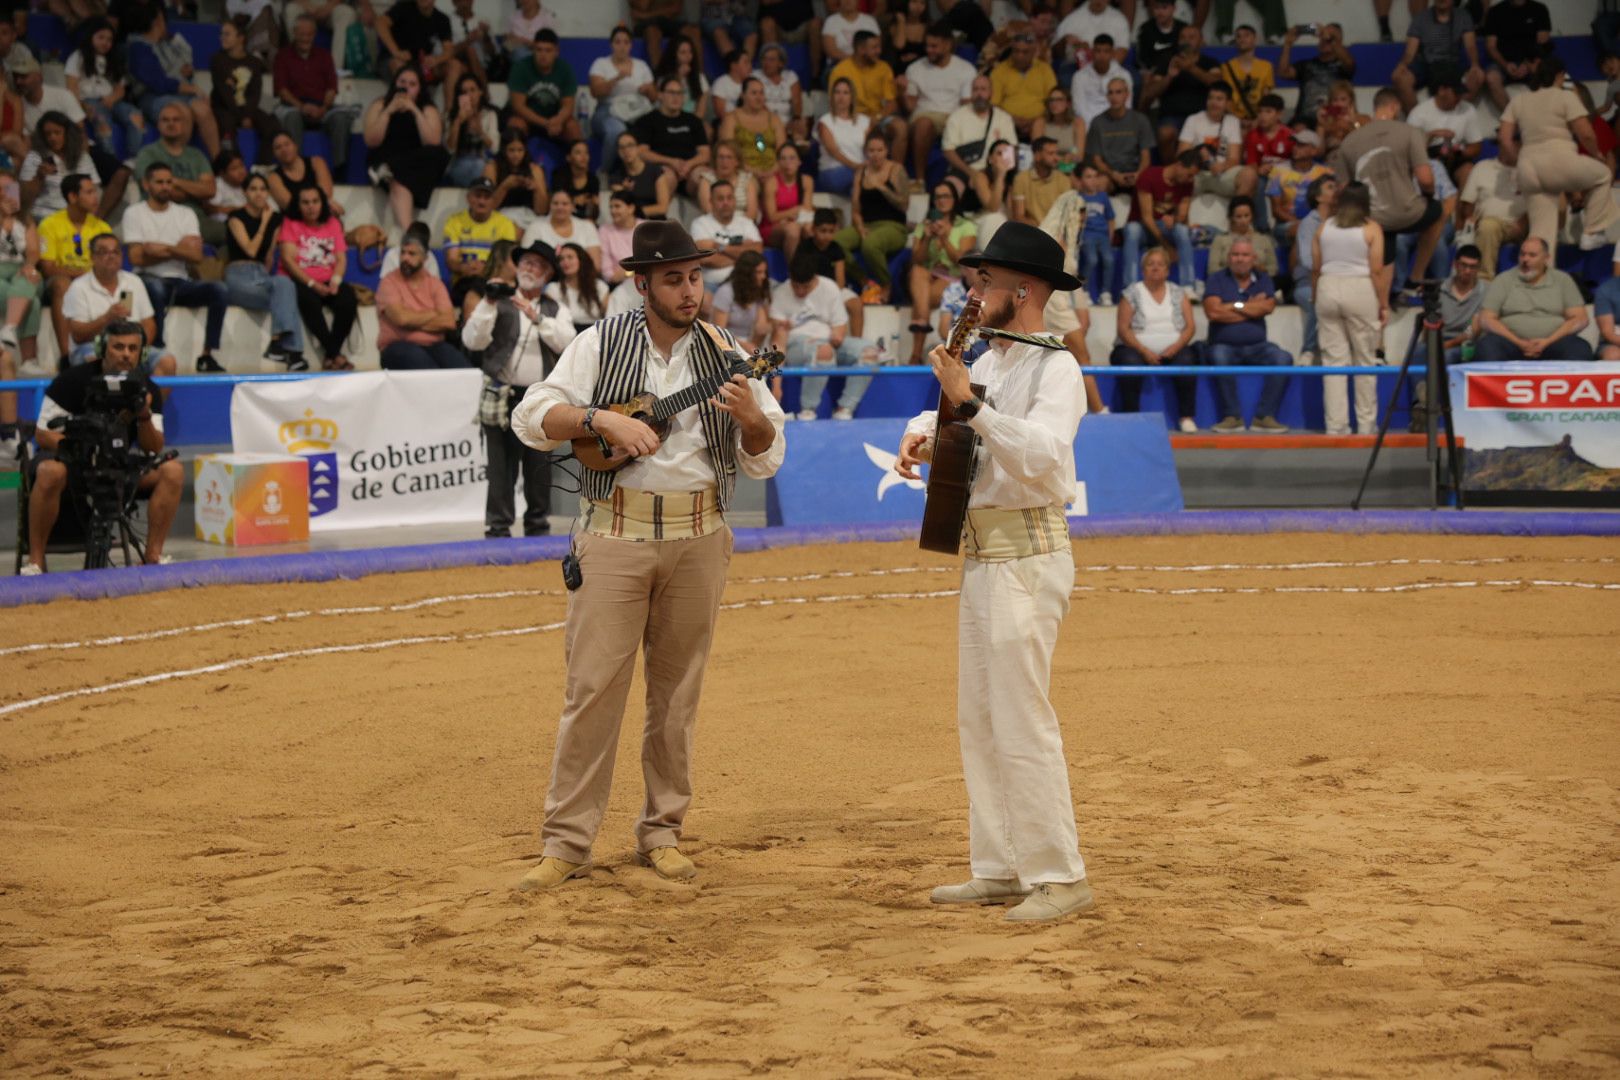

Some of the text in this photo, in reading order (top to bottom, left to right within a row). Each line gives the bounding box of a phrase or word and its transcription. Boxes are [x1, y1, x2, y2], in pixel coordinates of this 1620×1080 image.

[1505, 411, 1553, 422] GRAN
[350, 439, 472, 473] Gobierno
[351, 477, 383, 500] de
